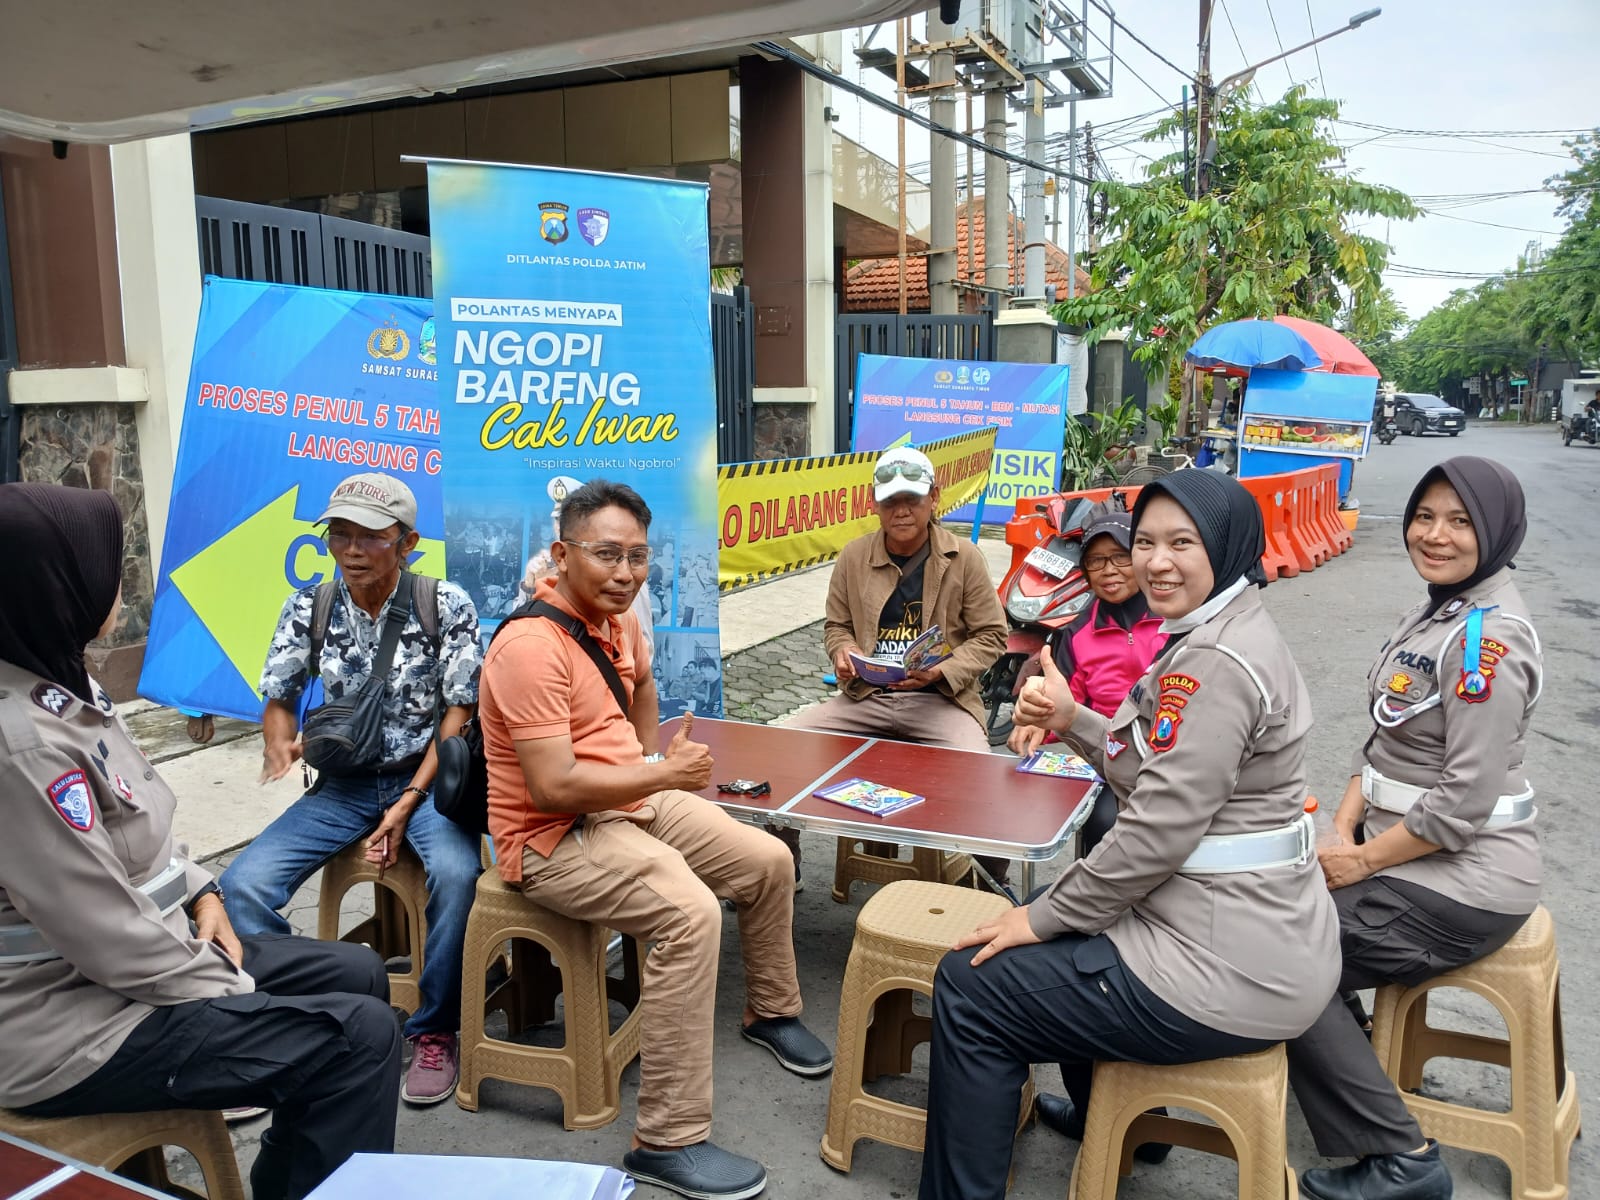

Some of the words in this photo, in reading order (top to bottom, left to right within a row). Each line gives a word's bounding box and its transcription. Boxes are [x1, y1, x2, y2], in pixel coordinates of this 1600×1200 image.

[506, 254, 570, 266] DITLANTAS
[572, 258, 611, 269] POLDA
[613, 260, 646, 270] JATIM
[457, 303, 540, 317] POLANTAS
[544, 306, 617, 321] MENYAPA
[453, 330, 603, 367] NGOPI
[361, 362, 402, 376] SAMSAT
[455, 370, 641, 406] BARENG
[198, 383, 287, 415] PROSES
[293, 394, 368, 426] PENUL
[374, 404, 389, 428] 5
[862, 393, 903, 407] PROSES
[905, 398, 939, 409] PENUL
[950, 399, 984, 411] TAHUN
[991, 402, 1014, 413] BBN
[1022, 402, 1060, 415] MUTASI
[480, 399, 568, 450] Cak
[575, 396, 679, 446] Iwan
[905, 411, 960, 425] LANGSUNG
[963, 415, 984, 426] CEK
[288, 432, 417, 472] LANGSUNG
[584, 458, 625, 469] Waktu
[334, 482, 357, 498] NEW
[359, 481, 390, 505] YORK
[748, 487, 847, 544] DILARANG
[1393, 650, 1435, 676] POLRI
[1163, 677, 1194, 690] POLDA
